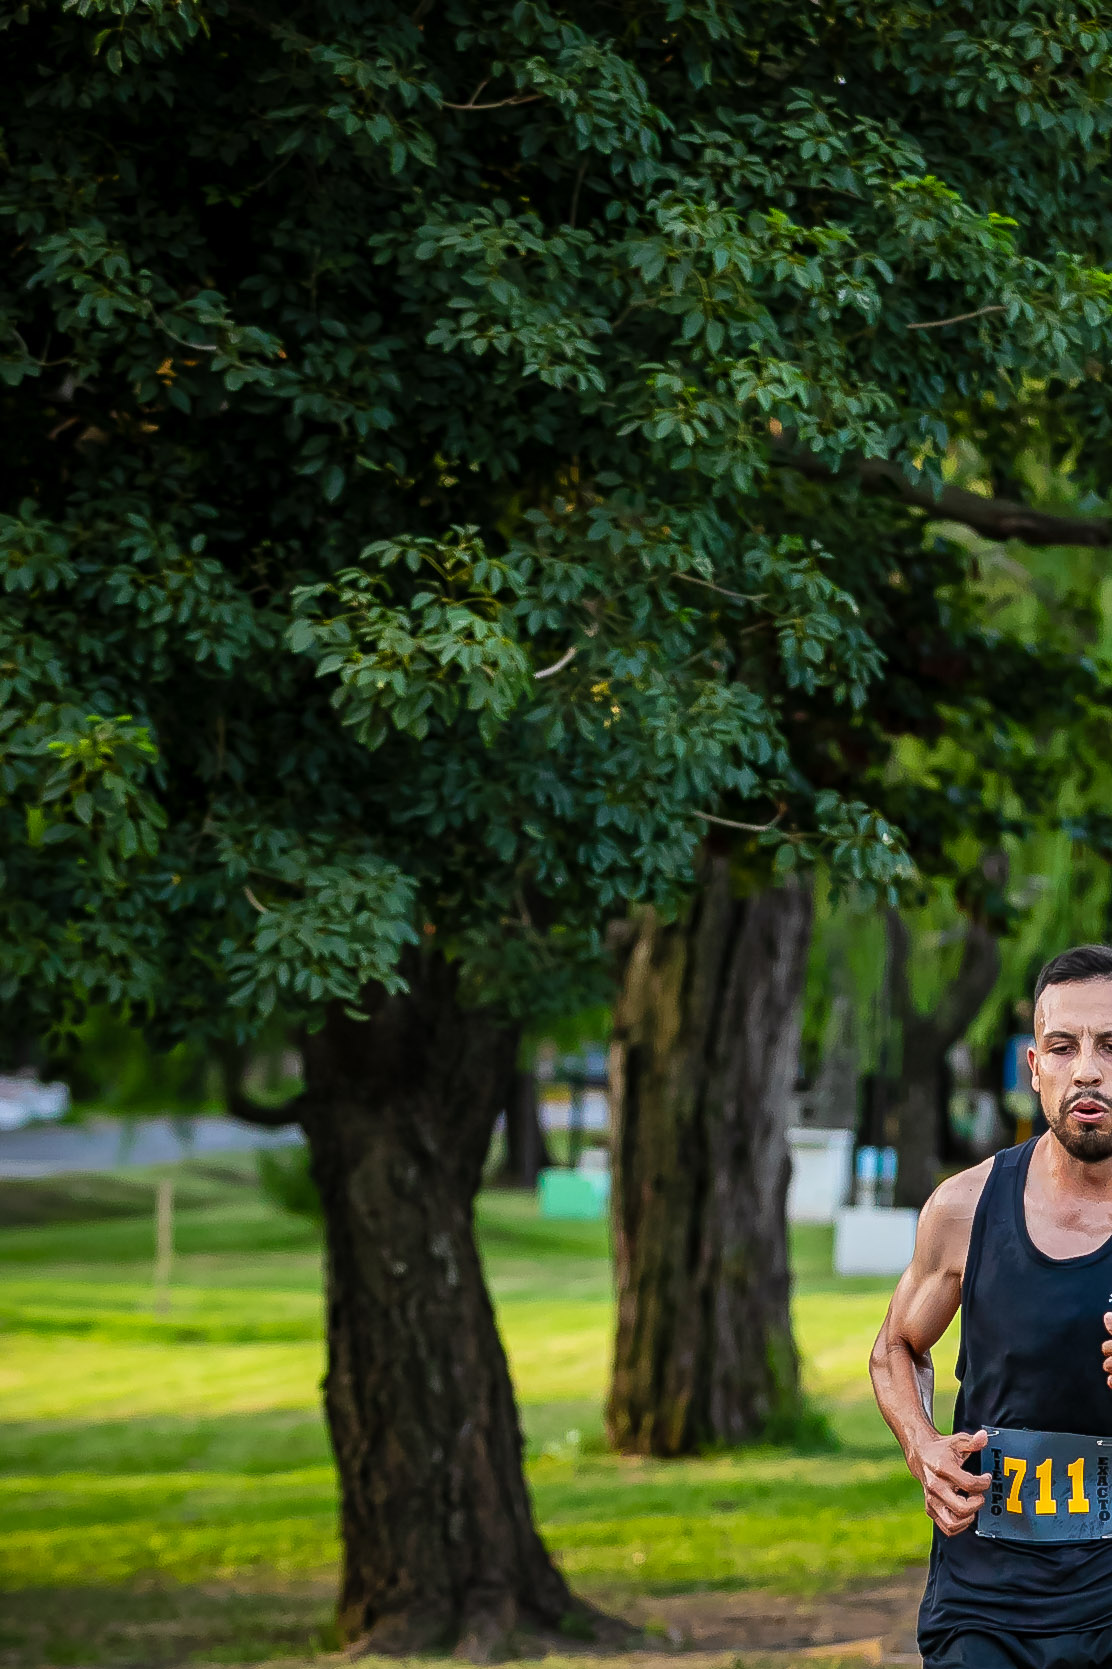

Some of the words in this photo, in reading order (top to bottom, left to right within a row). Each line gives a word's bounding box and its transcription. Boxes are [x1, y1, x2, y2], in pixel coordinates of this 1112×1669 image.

[990, 1448, 1002, 1516] TIEMPO
[1003, 1456, 1090, 1515] 711
[1096, 1457, 1110, 1522] EXACTO
